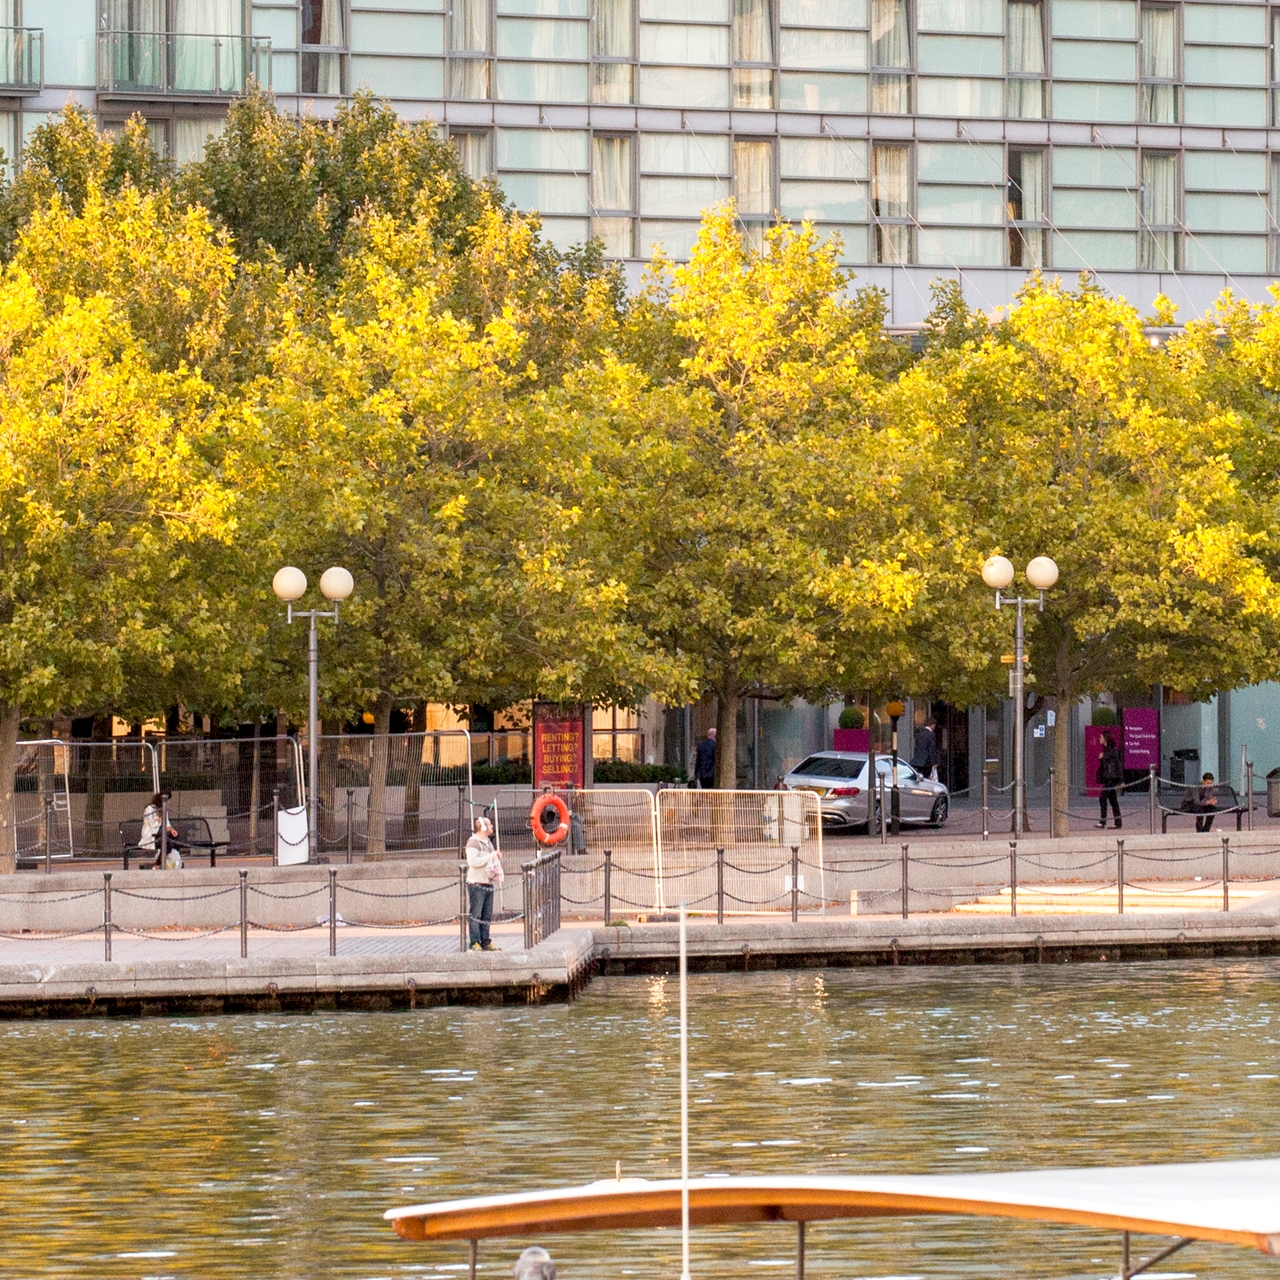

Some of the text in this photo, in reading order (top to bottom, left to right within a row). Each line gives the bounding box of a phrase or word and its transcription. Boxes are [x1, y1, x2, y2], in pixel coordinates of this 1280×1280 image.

[541, 733, 579, 742] RENTING?
[542, 743, 578, 753] LETTING?
[543, 754, 577, 763] BUYING?
[542, 765, 578, 775] SELLING?
